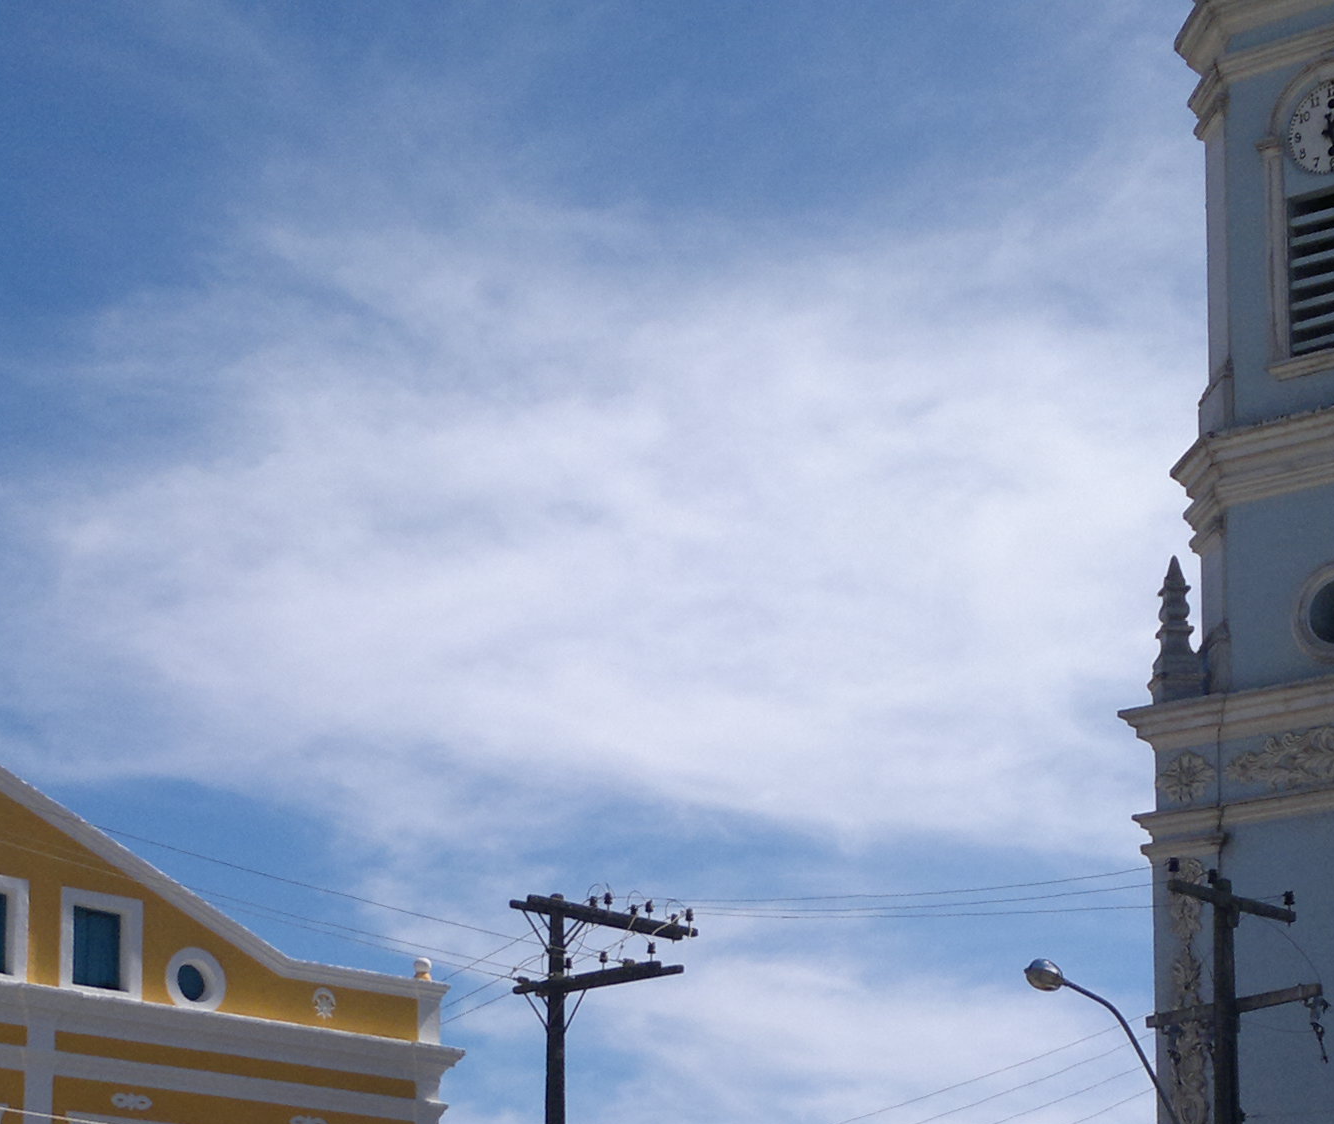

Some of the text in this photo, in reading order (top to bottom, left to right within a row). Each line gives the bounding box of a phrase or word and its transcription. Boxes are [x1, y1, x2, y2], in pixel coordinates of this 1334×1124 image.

[1310, 97, 1320, 108] 11
[1299, 111, 1310, 124] 10
[1294, 132, 1302, 143] 9
[1299, 147, 1307, 160] 8
[1313, 156, 1320, 168] 7
